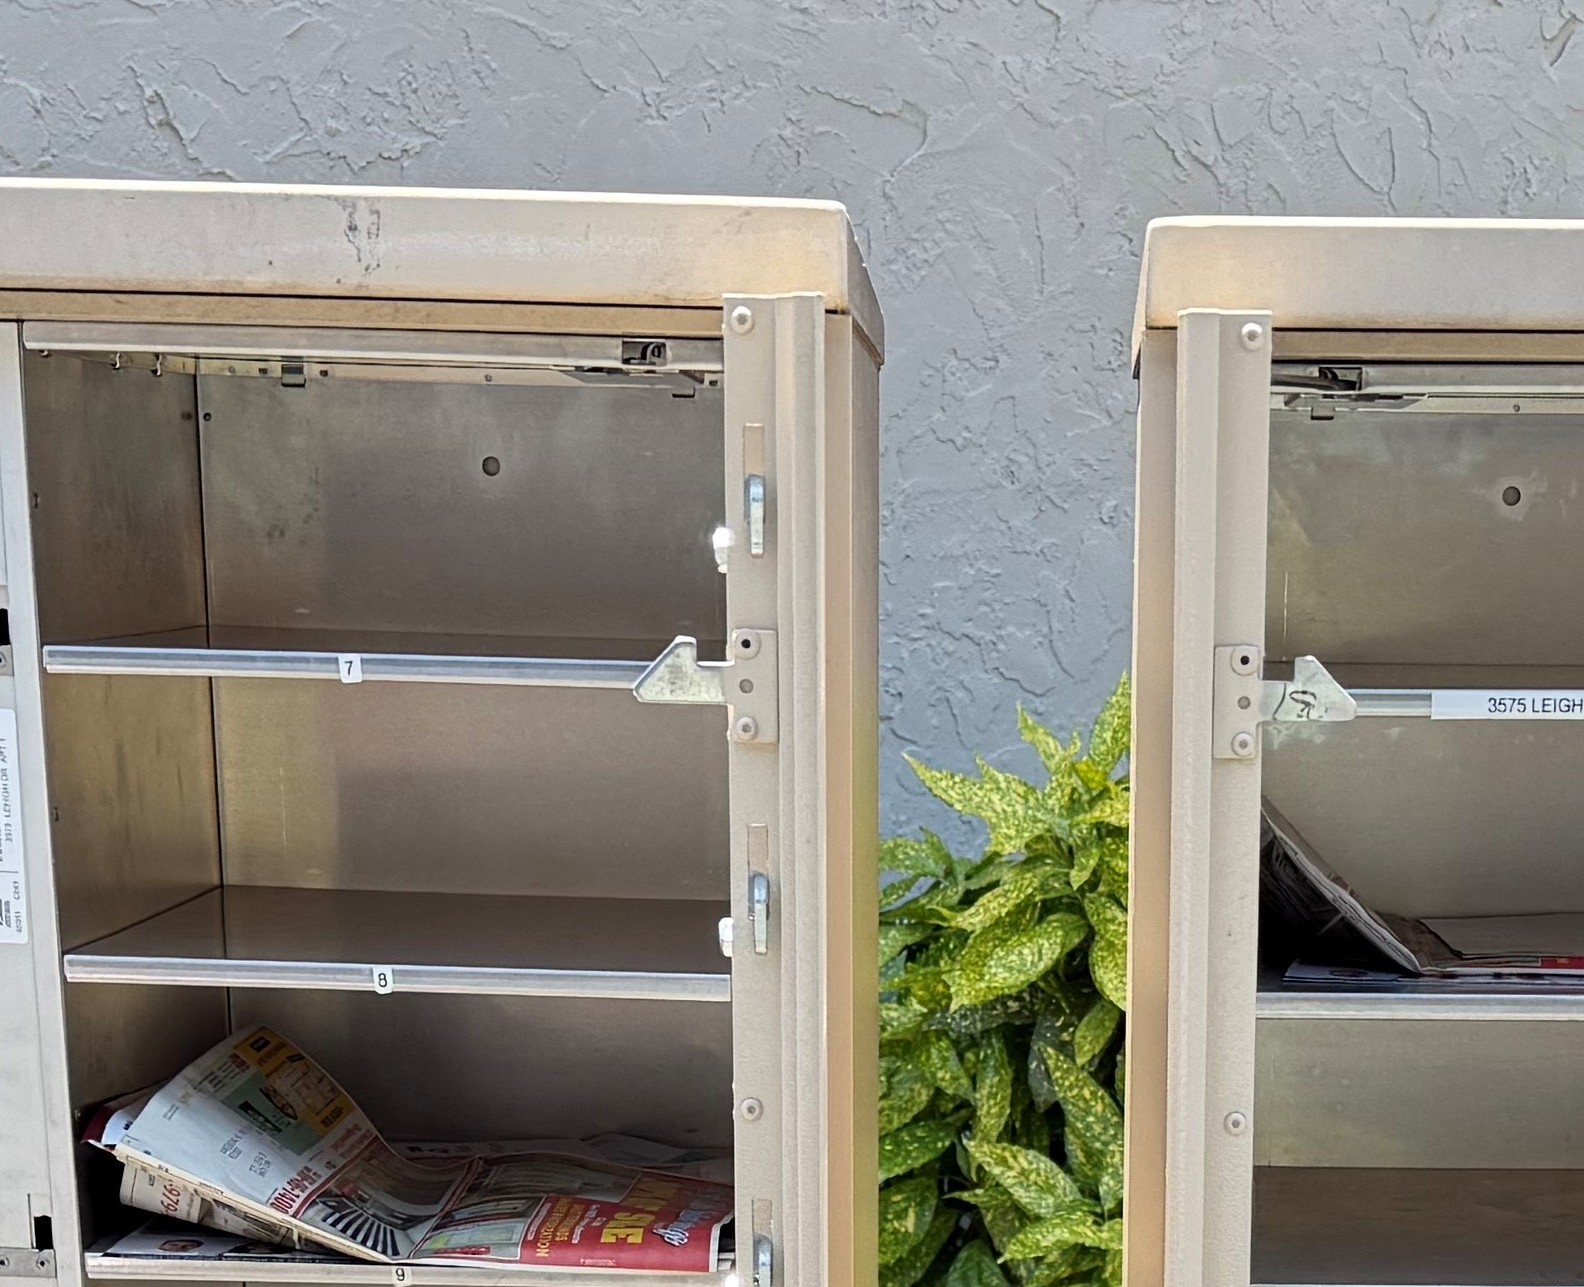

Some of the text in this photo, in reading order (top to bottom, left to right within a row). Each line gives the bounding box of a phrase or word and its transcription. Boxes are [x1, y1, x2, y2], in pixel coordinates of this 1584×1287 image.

[344, 660, 354, 676] 7
[1487, 697, 1527, 713] 3575
[1531, 697, 1583, 713] LEIGH
[377, 972, 388, 988] 8
[395, 1267, 406, 1282] 9
